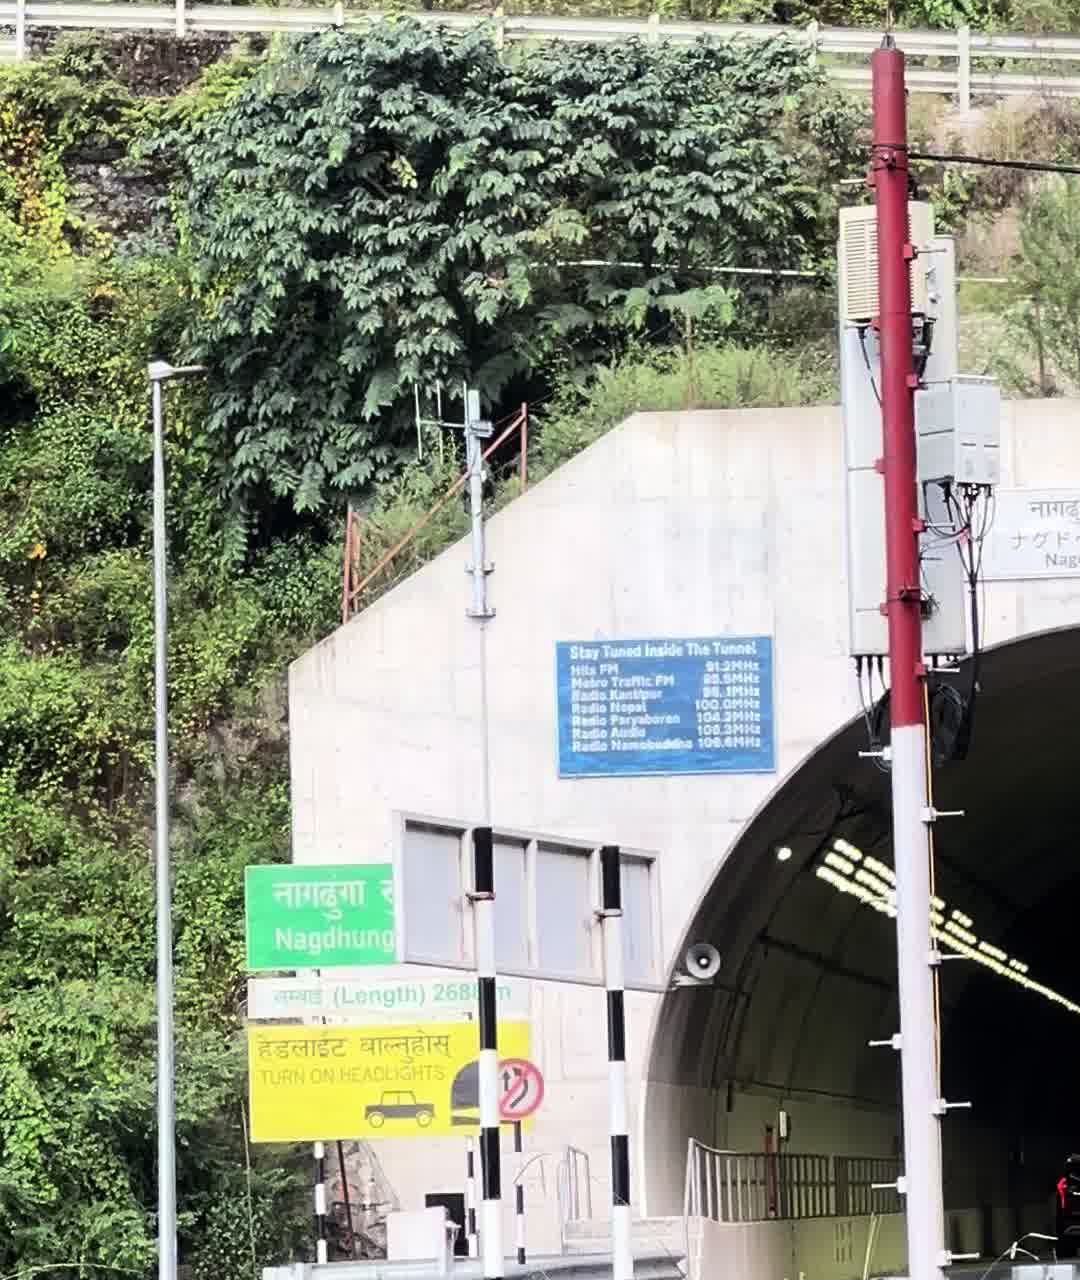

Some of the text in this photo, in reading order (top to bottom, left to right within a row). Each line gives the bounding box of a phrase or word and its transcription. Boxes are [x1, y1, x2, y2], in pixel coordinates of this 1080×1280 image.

[570, 640, 757, 661] Stay Tuned Inside The Tunnel
[599, 663, 619, 675] FM
[655, 674, 675, 687] FM
[334, 983, 426, 1009] (Length)
[260, 1064, 446, 1086] TURN ON HEADLIGHTS
